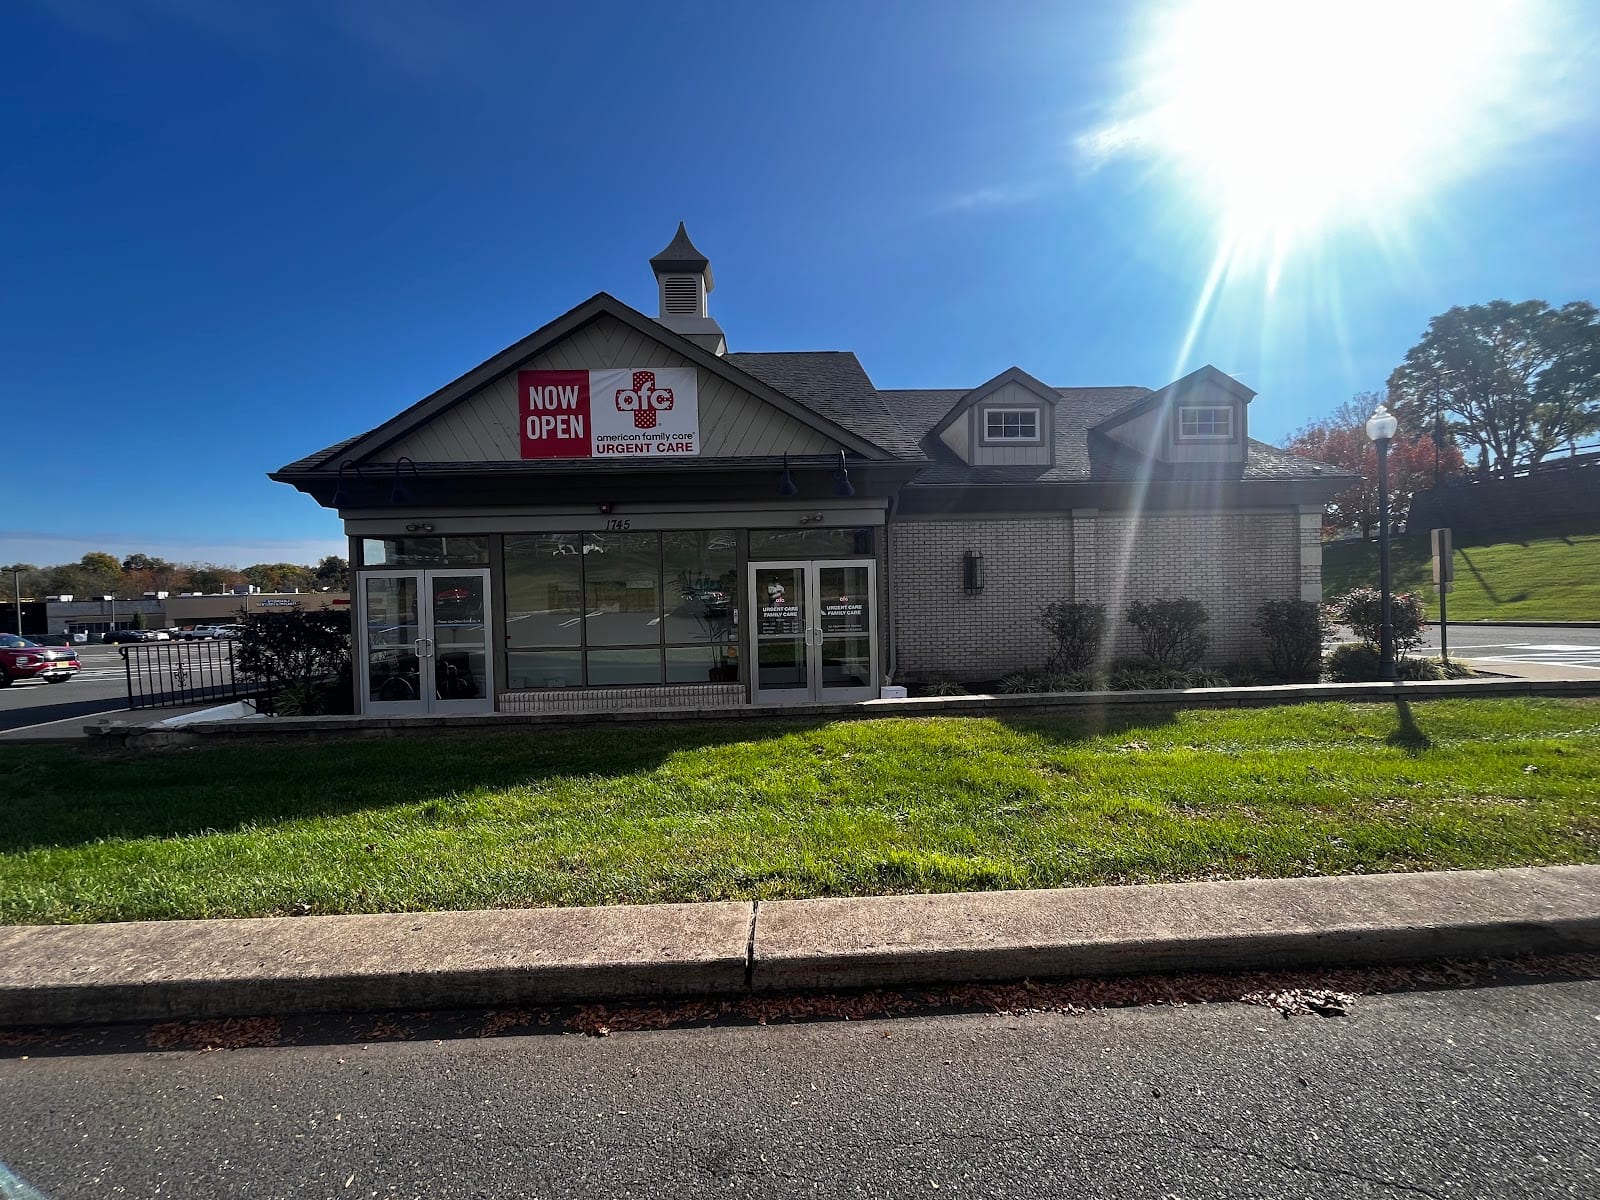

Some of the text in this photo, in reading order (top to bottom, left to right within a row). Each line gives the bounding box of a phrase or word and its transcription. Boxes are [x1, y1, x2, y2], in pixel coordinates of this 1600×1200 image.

[529, 385, 579, 410] NOW
[618, 381, 671, 410] afc
[526, 414, 584, 440] OPEN
[596, 432, 693, 441] american family care
[596, 442, 694, 454] URGENT CARE
[606, 519, 630, 530] 1745
